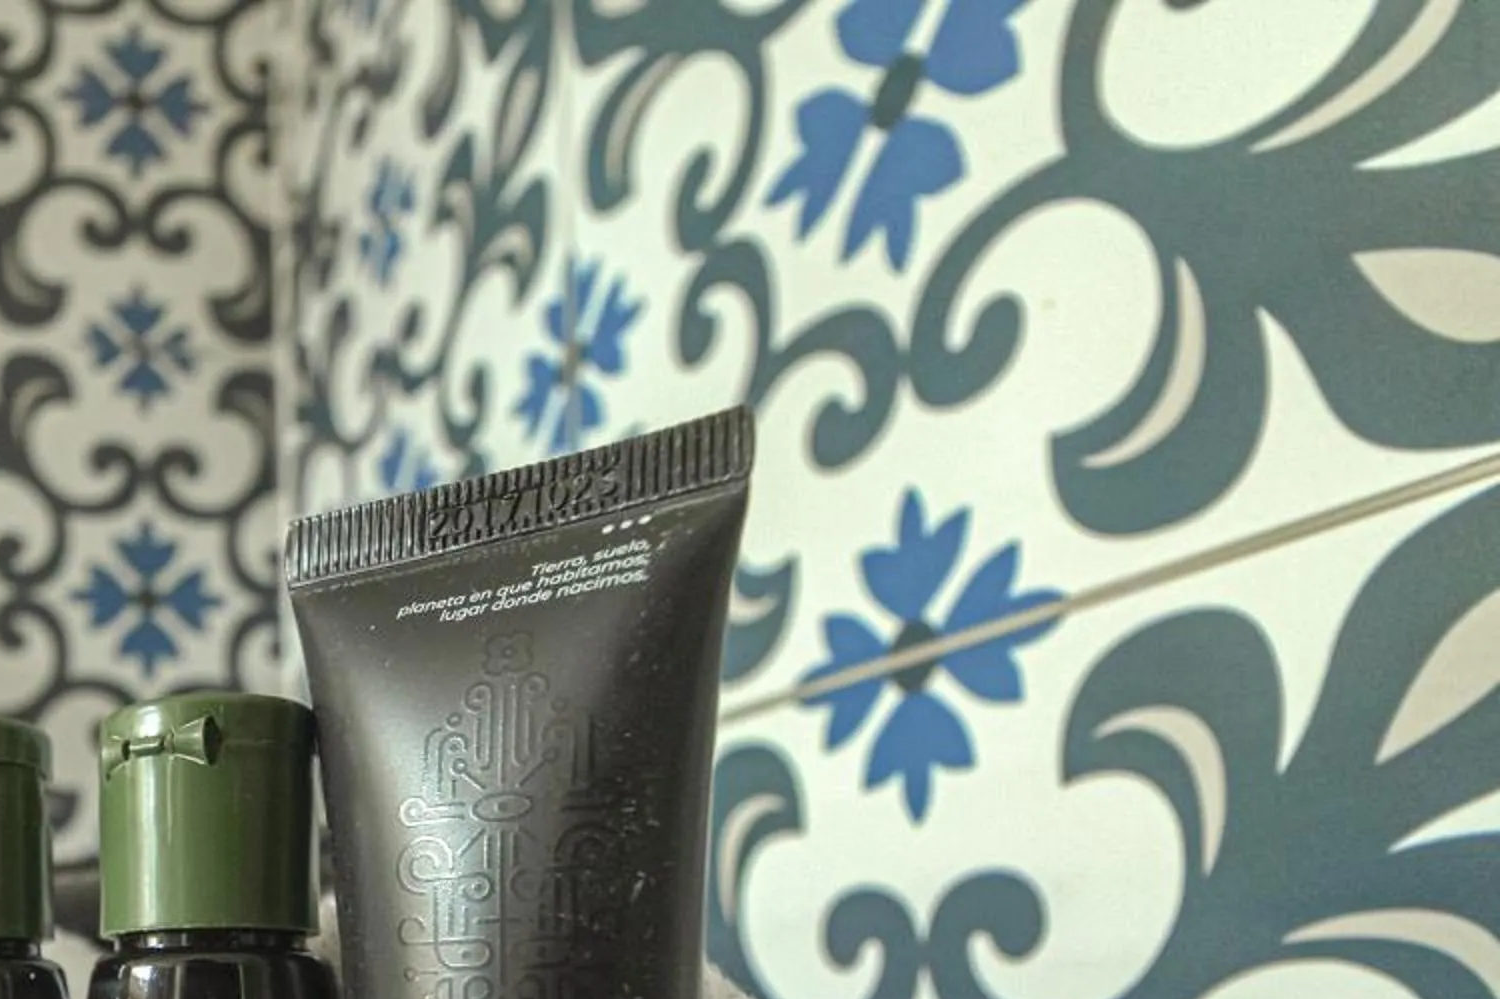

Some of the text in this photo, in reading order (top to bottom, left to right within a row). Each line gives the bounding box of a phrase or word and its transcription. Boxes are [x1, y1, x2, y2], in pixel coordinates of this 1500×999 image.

[397, 593, 466, 619] planeta
[495, 580, 533, 600] que
[440, 604, 488, 622] lugar
[491, 588, 552, 612] donde
